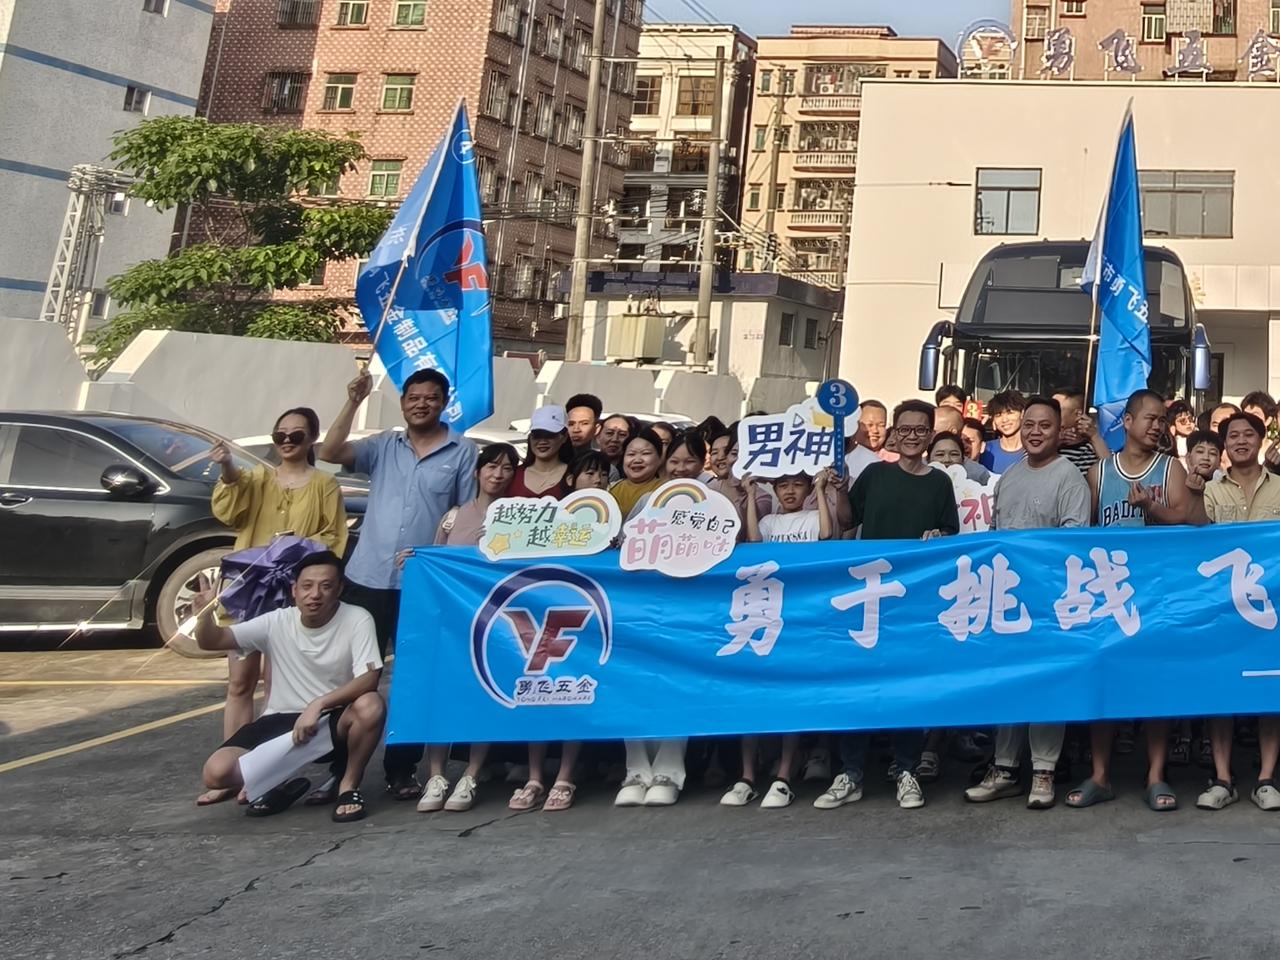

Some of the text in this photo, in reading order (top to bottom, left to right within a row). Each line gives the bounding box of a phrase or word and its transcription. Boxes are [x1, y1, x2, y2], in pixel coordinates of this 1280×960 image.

[828, 383, 848, 409] 3
[743, 422, 836, 470] 男神
[492, 502, 558, 525] 越努力
[671, 510, 735, 534] 感觉自己
[526, 523, 595, 547] 越幸运
[627, 518, 731, 565] 萌萌哒
[716, 548, 1142, 657] 勇于挑战
[517, 678, 593, 696] 勇飞五金
